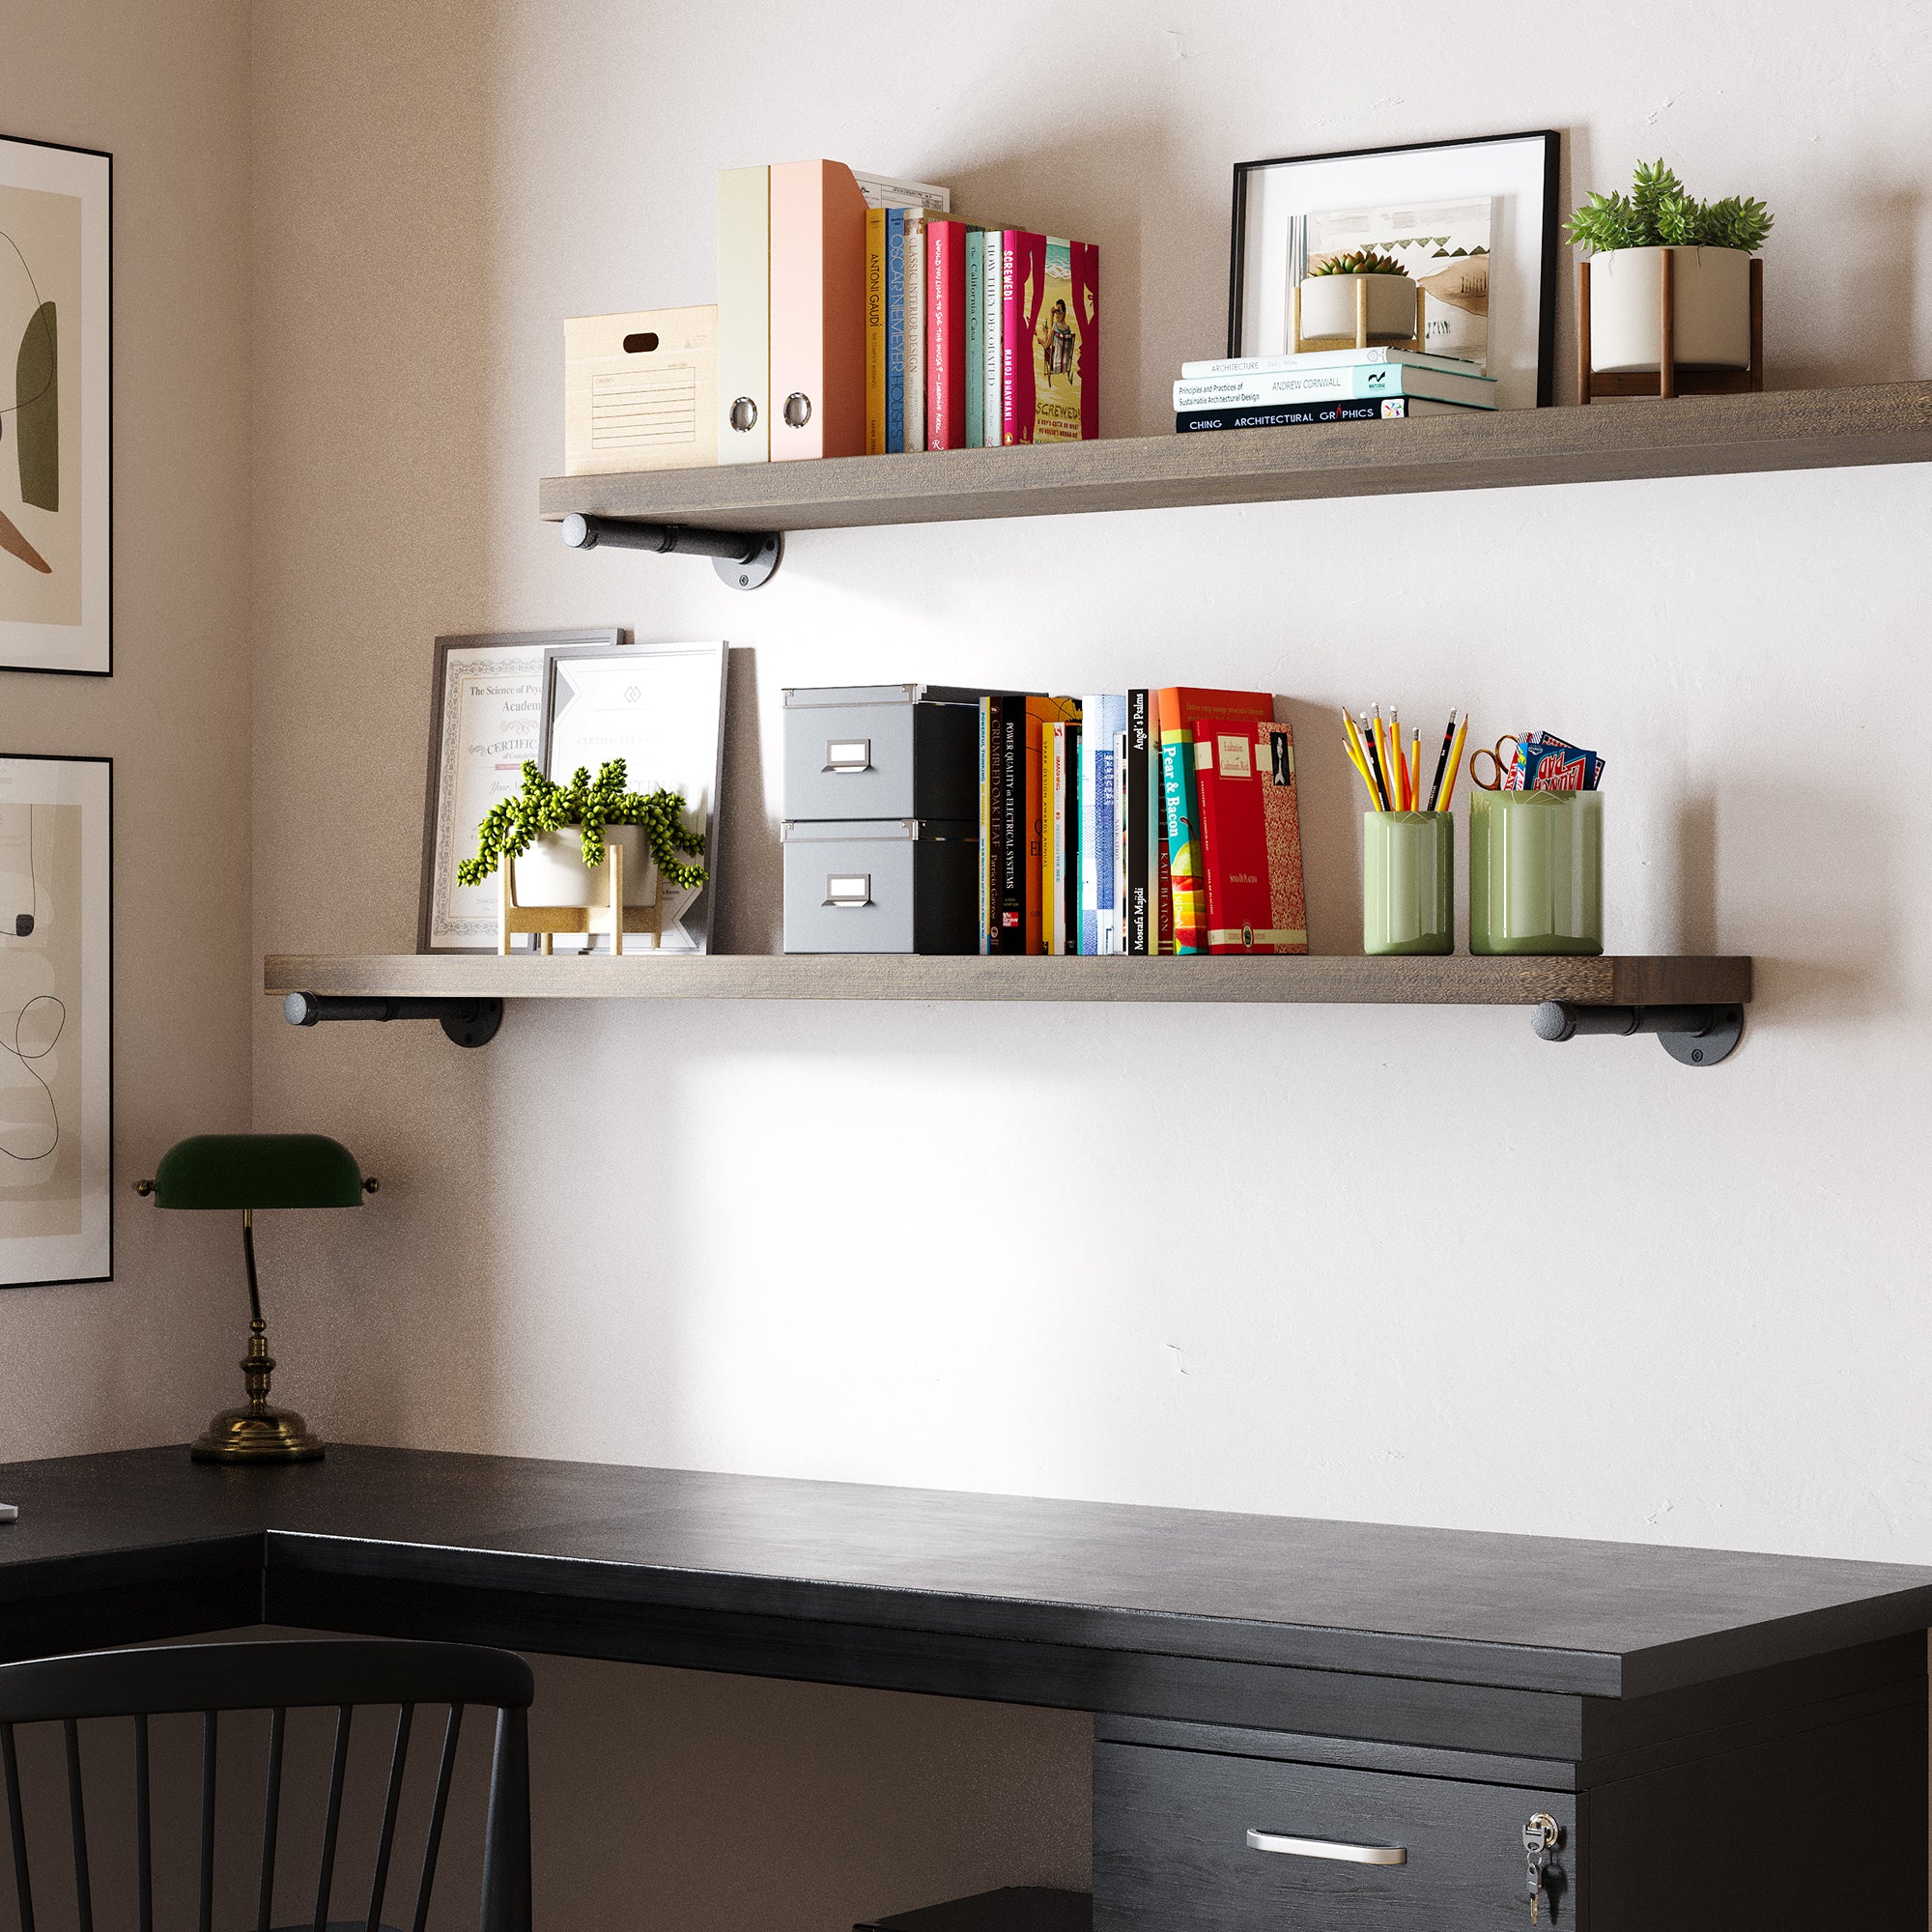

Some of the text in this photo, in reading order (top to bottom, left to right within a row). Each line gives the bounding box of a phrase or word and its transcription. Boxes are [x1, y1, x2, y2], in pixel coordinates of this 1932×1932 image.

[891, 234, 904, 291] OSCAR
[987, 244, 996, 271] HOW
[870, 253, 882, 327] ANTONI GAUDÍ
[909, 238, 918, 372] CLASSIC INTERIOR DESIGN
[987, 276, 996, 307] THEY
[891, 295, 904, 371] NIEMEYER
[987, 313, 996, 386] DECORATED
[1004, 349, 1012, 421] MANOJ BHAVNANI
[1211, 362, 1259, 373] ARCHITECTURE
[1271, 378, 1341, 391] ANDREW CORNWALL
[1179, 386, 1203, 395] Principles
[1213, 383, 1236, 392] Practices
[1179, 392, 1260, 407] Sustainable Architectural Design
[891, 376, 904, 439] HOUSES
[1036, 402, 1081, 420] SCREWED!
[1189, 403, 1375, 430] CHING ARCHITECTURAL GRAPHICS
[469, 686, 484, 696] The
[486, 685, 515, 695] Science
[516, 685, 525, 694] of
[1133, 693, 1145, 720] Psalms
[1006, 723, 1014, 750] POWER
[991, 720, 1001, 848] CRUMBLED OAK LEAF
[1005, 752, 1014, 788] QUALITY
[1163, 746, 1180, 838] Pear & Bacon
[1006, 798, 1014, 849] ELECTRICAL
[1006, 850, 1014, 889] SYSTEMS
[1134, 887, 1148, 914] Majidi
[1160, 851, 1169, 932] KATE BEATON
